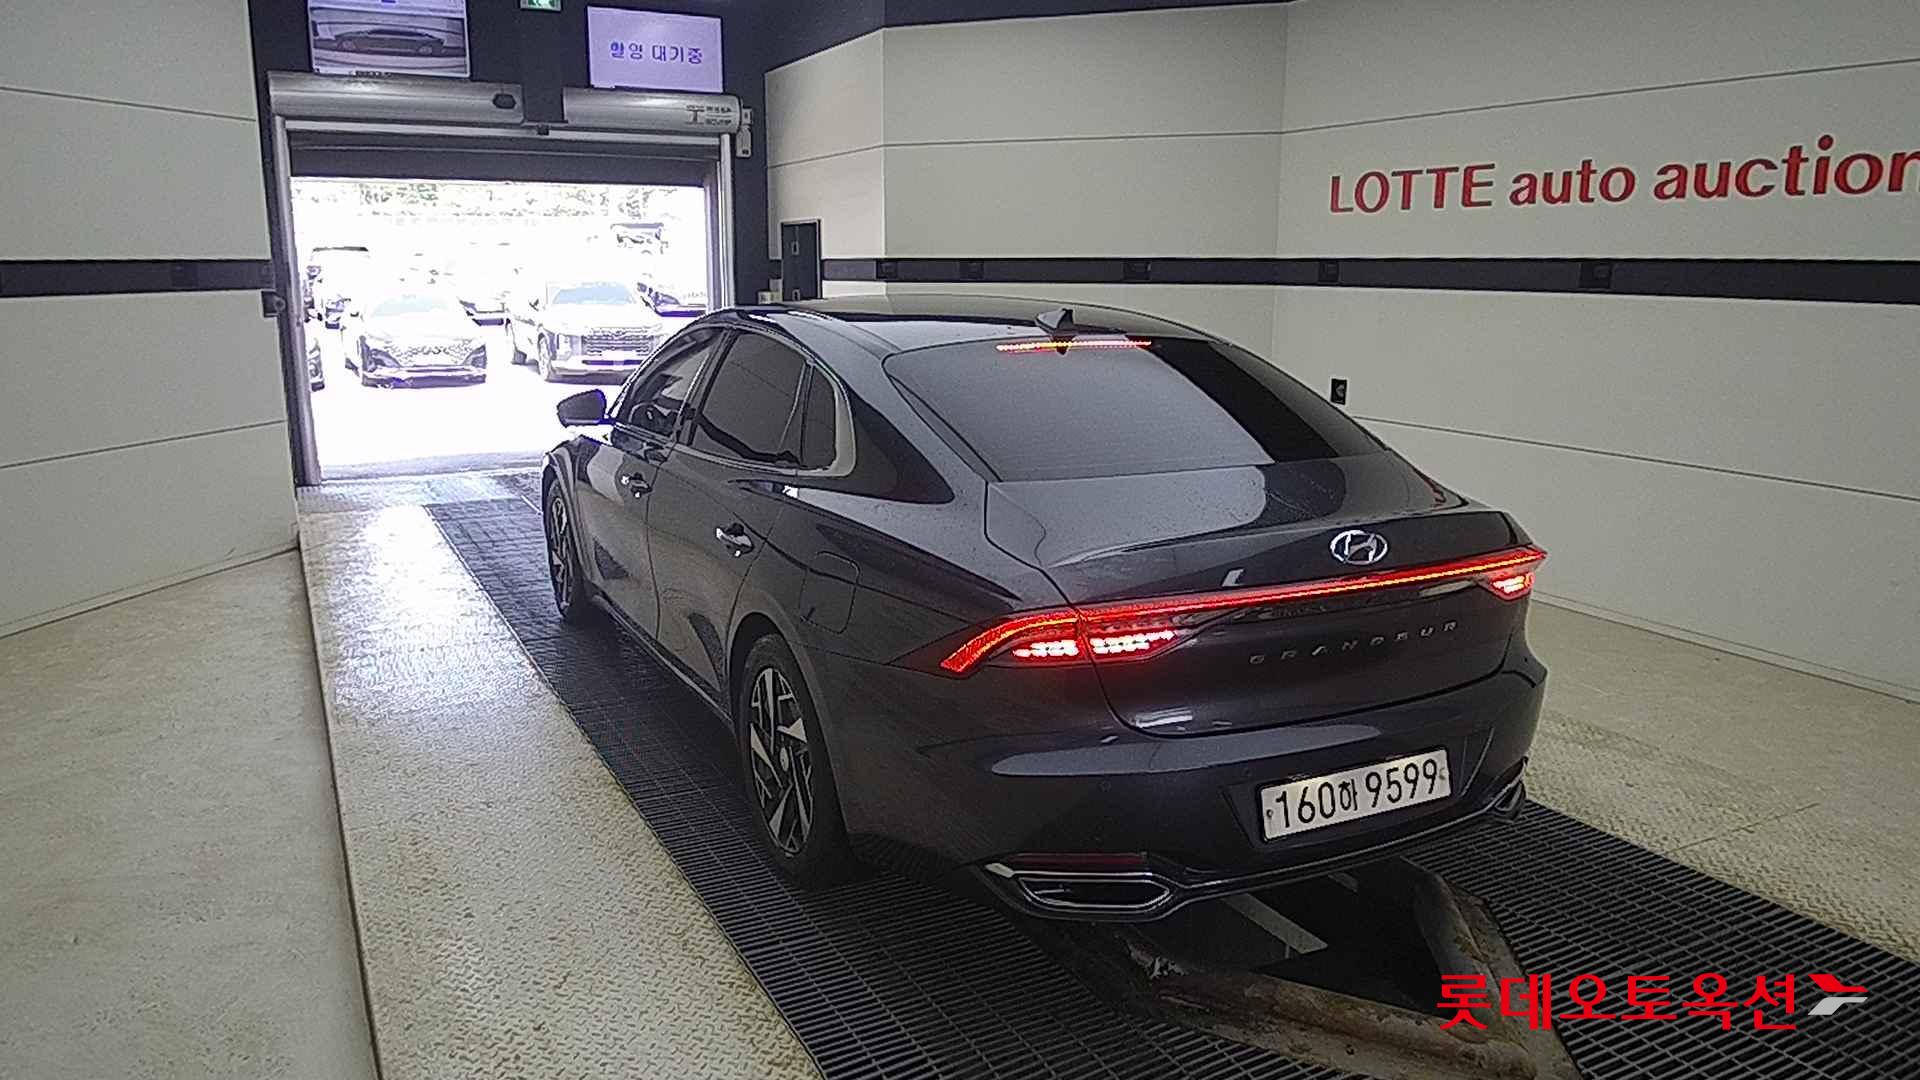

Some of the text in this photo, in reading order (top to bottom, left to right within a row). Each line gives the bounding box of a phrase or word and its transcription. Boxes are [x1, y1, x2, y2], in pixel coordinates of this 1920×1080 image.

[651, 44, 703, 65] 대기중
[1330, 163, 1496, 214] LOTTE
[1509, 159, 1636, 205] auto
[1249, 621, 1457, 665] GRANDEUR
[1365, 758, 1438, 809] 9599
